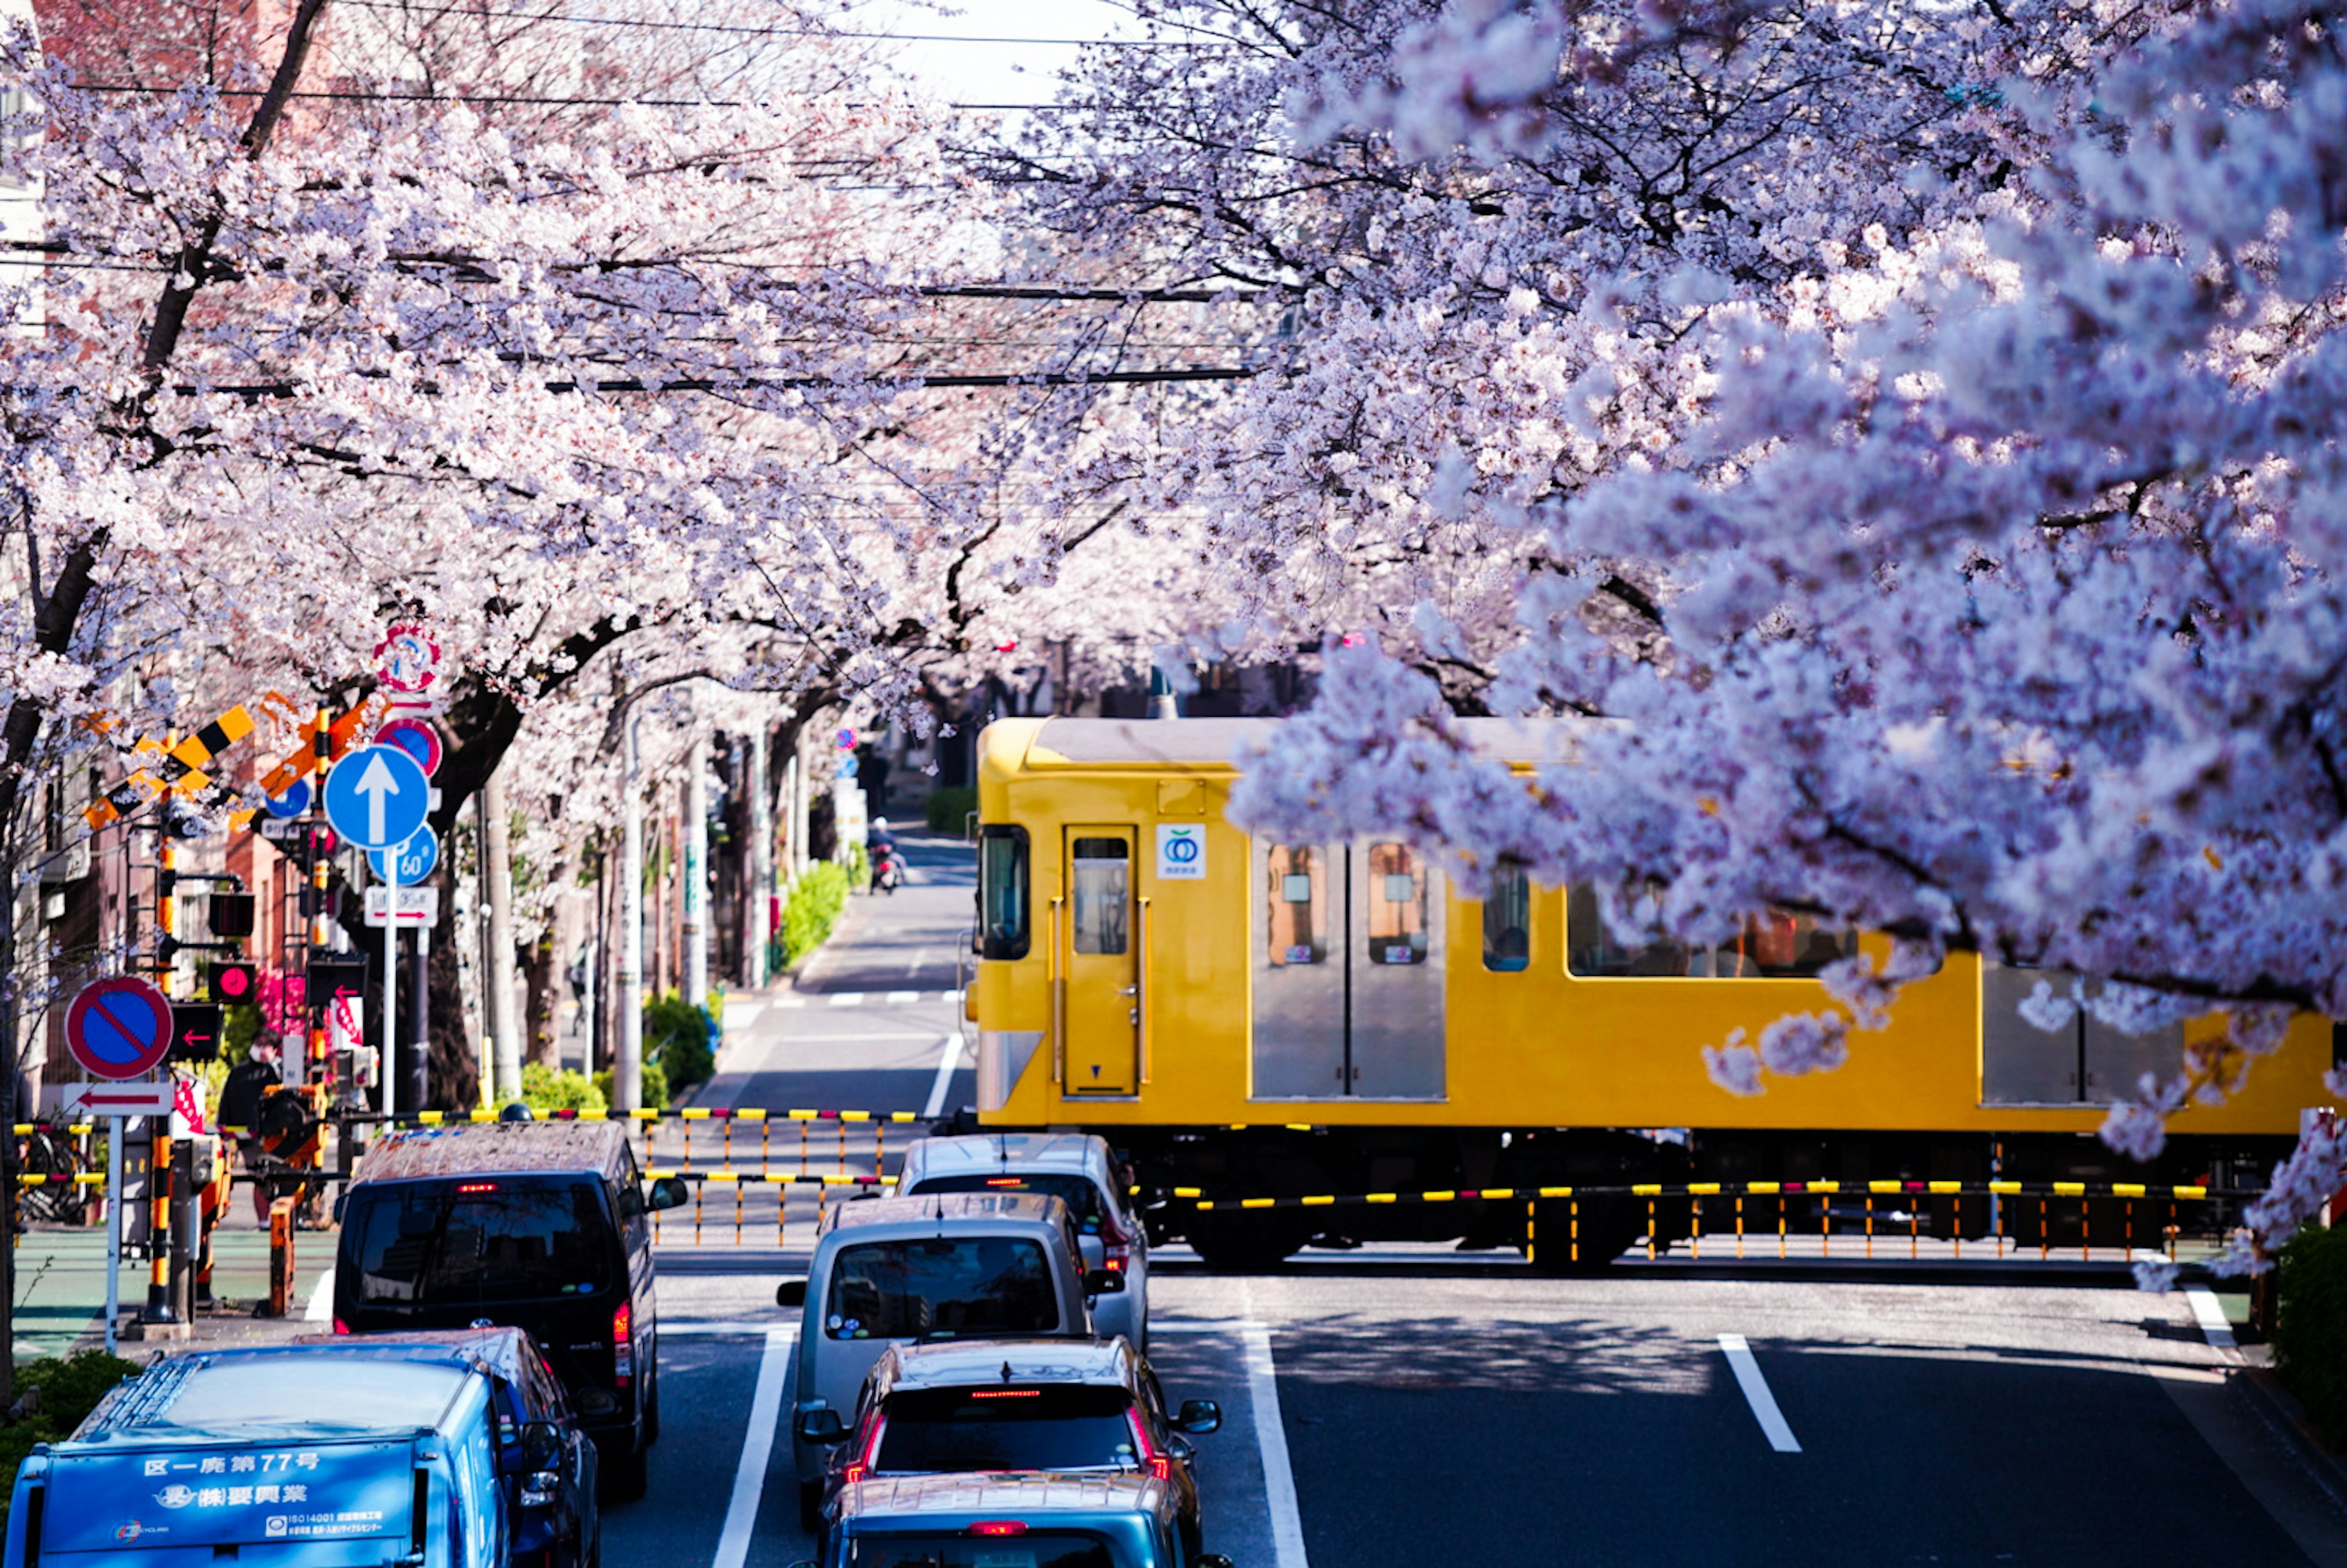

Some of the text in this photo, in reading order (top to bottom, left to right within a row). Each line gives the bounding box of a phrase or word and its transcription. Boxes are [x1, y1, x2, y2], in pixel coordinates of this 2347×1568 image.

[144, 1453, 320, 1476] 区一廃第77号
[288, 1513, 334, 1523] ISO14001
